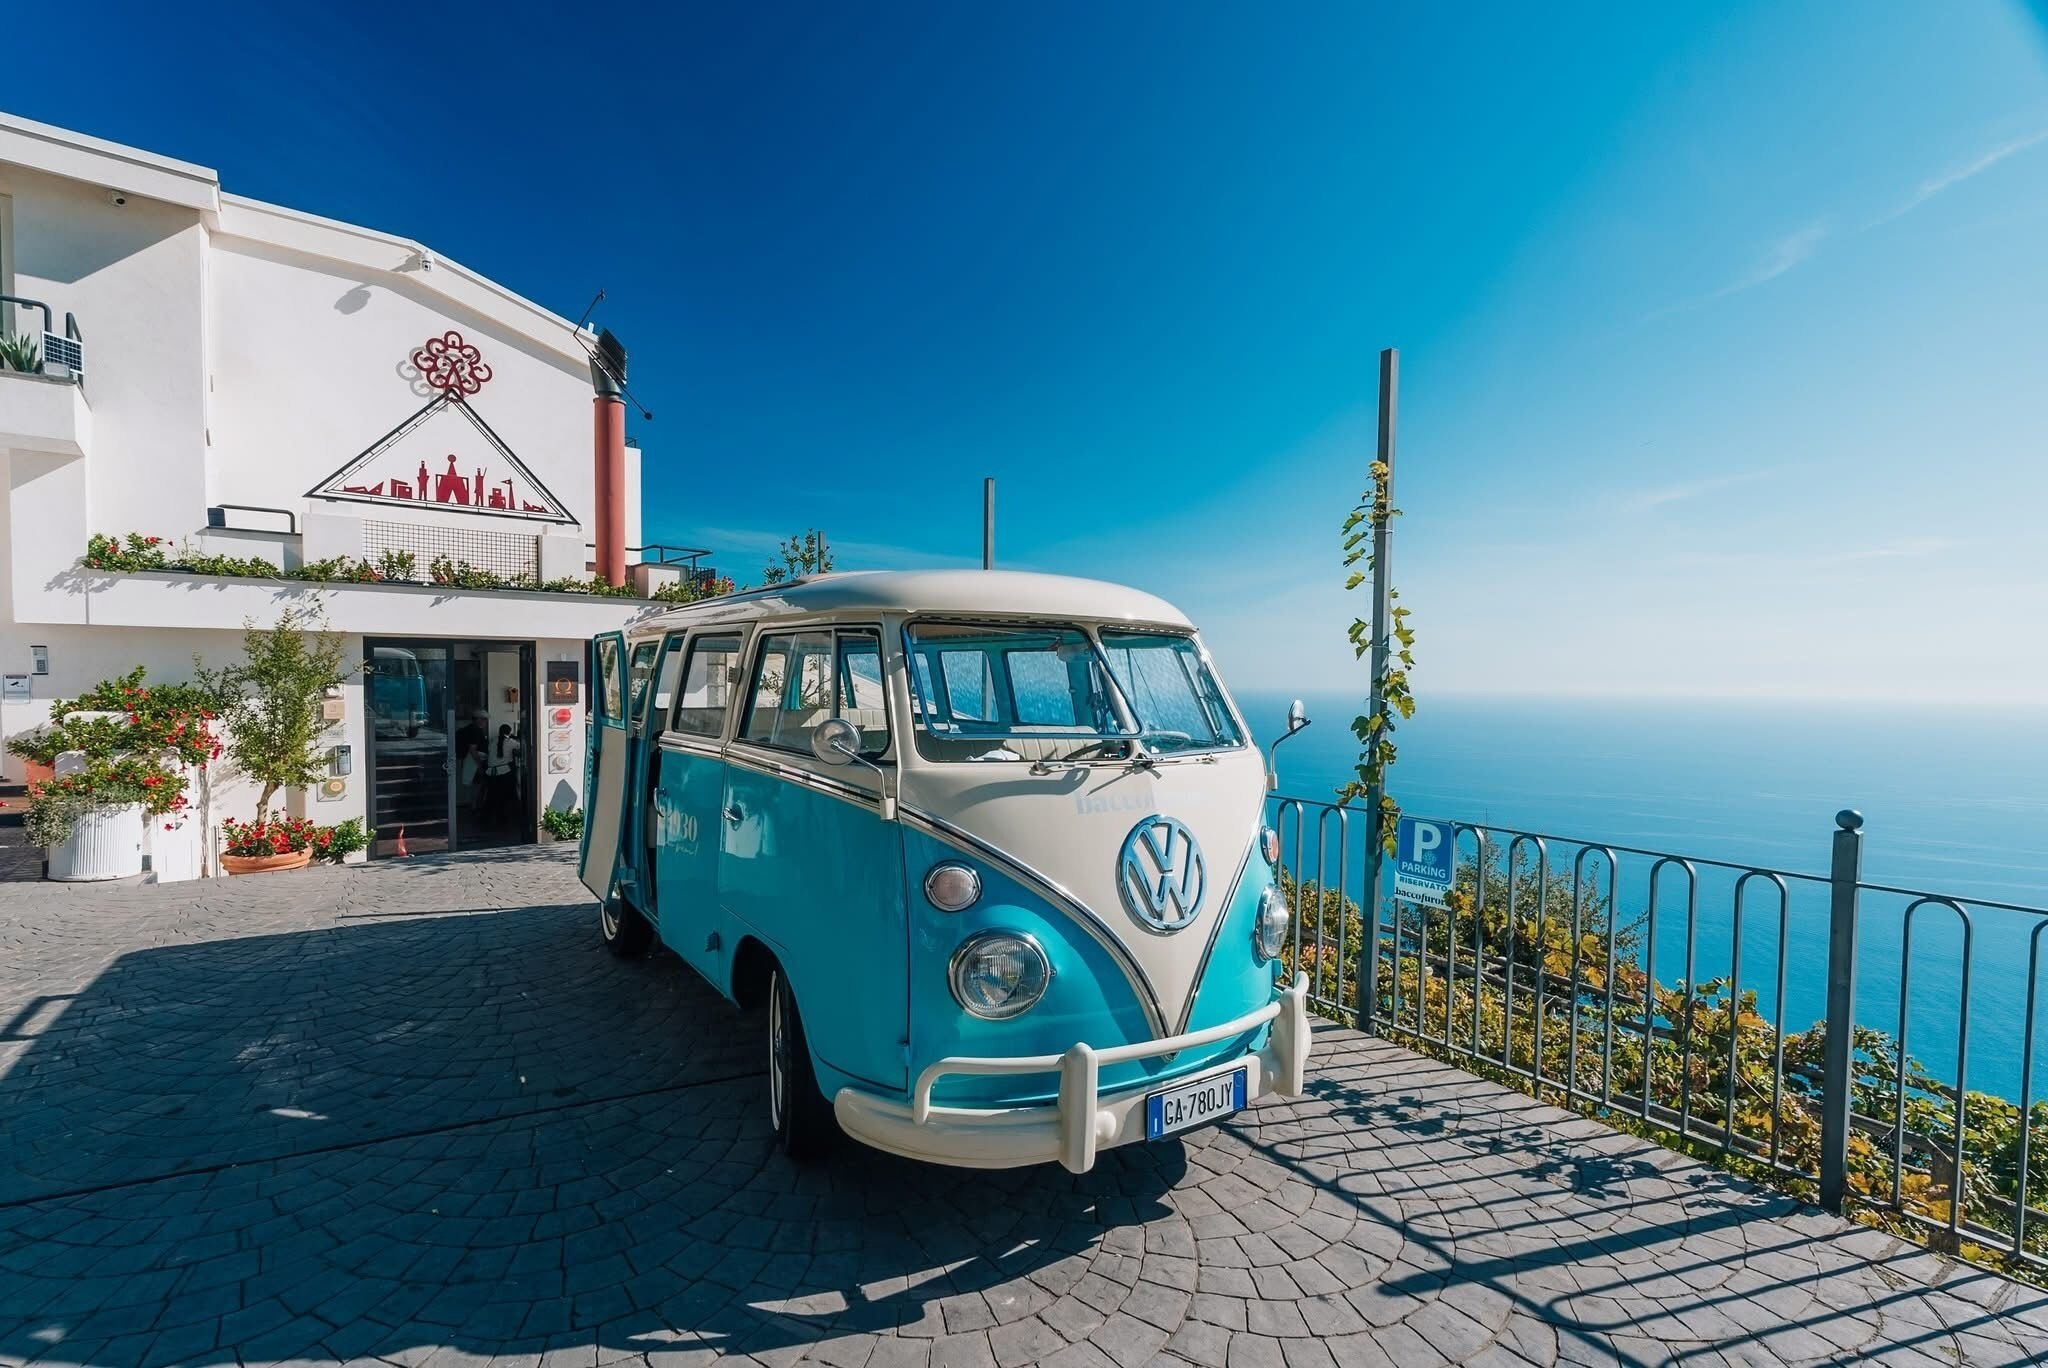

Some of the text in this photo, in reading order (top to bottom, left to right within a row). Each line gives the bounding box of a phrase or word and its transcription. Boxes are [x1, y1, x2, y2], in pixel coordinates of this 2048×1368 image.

[1413, 822, 1442, 862] P
[1401, 861, 1446, 879] PARKING
[1399, 876, 1448, 892] RISERVATO
[1395, 886, 1446, 906] baccofuror
